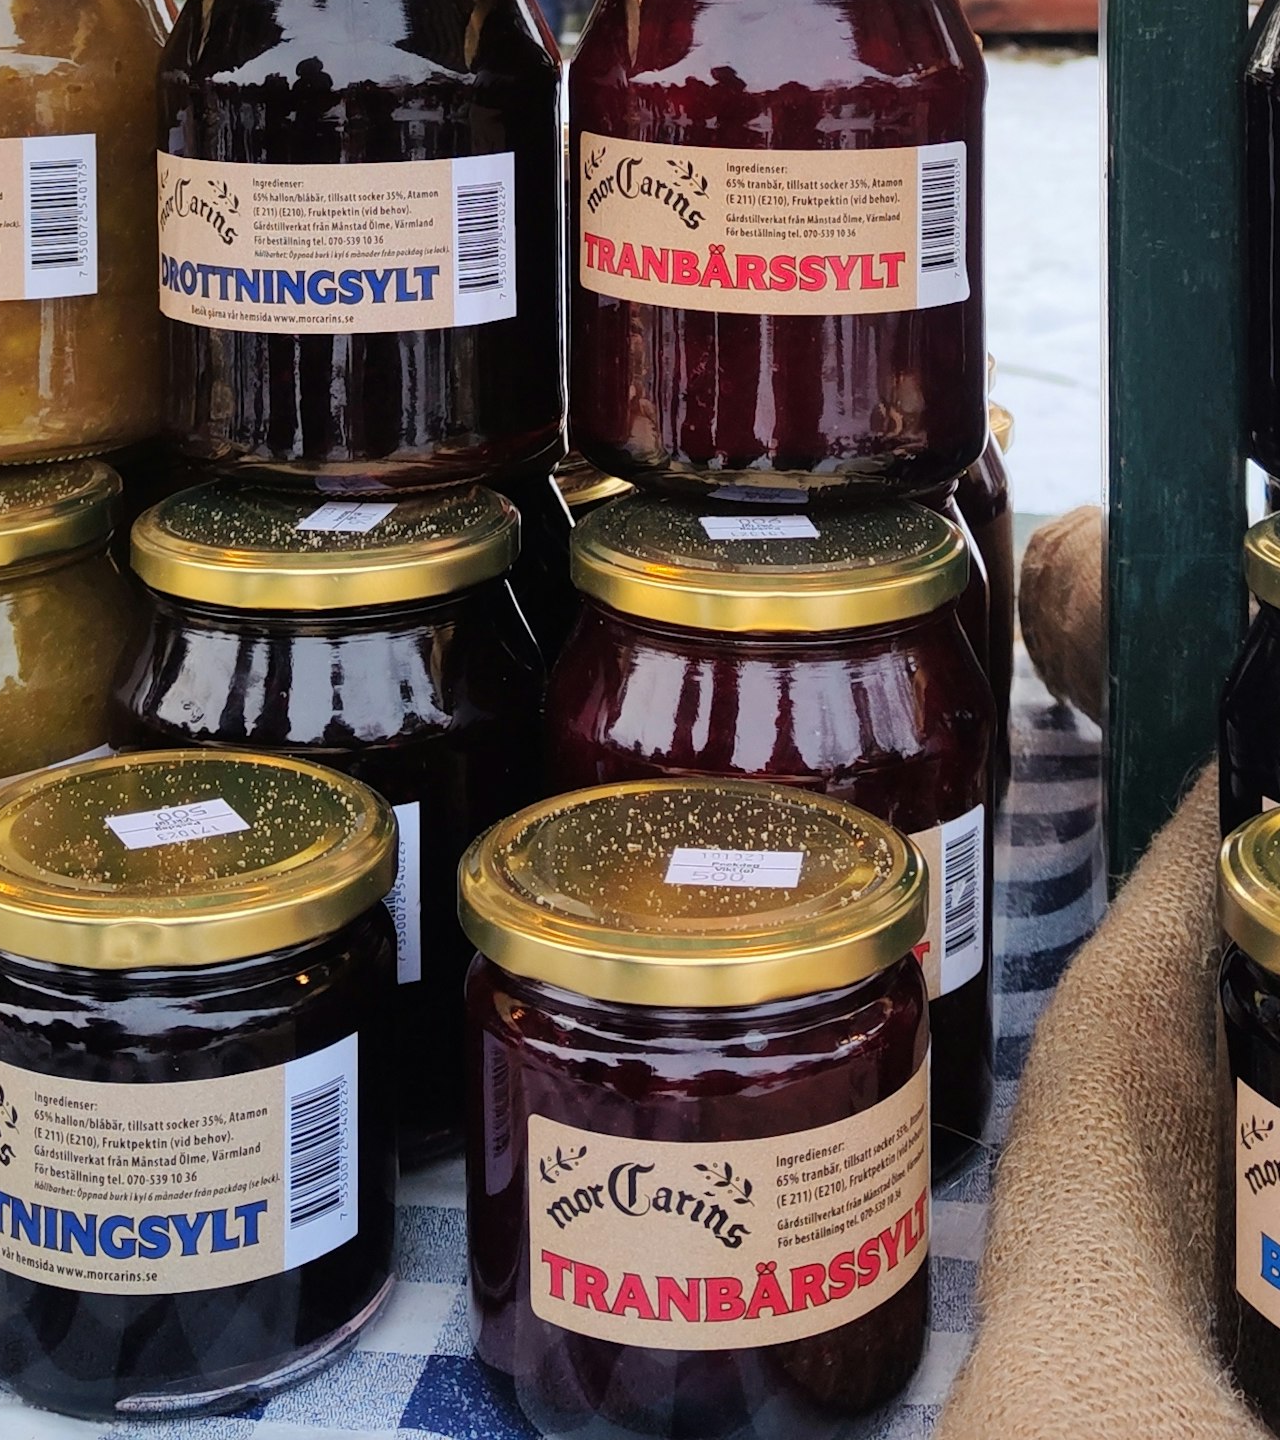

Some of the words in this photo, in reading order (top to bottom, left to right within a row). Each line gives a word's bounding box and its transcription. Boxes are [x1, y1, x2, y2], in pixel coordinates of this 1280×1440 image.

[174, 179, 238, 246] Carins
[586, 175, 614, 214] mor
[616, 157, 706, 230] Carins
[726, 178, 745, 189] 65%
[747, 179, 785, 190] tranbär,
[786, 180, 818, 190] tillsatt
[820, 180, 849, 190] socker
[850, 180, 870, 191] 35%,
[872, 177, 903, 189] Atamon
[160, 251, 440, 305] DROTTNINGSYLT
[584, 232, 906, 293] TRANBÄRSSYLT
[273, 314, 355, 325] www.morcarins.se
[34, 1110, 53, 1123] 65%
[55, 1115, 125, 1132] hallon/blåbär,
[128, 1120, 164, 1132] tillsatt
[166, 1118, 200, 1130] socker
[202, 1115, 227, 1127] 35%,
[228, 1107, 268, 1124] Atamon
[546, 1182, 603, 1230] mor
[608, 1162, 752, 1249] Carins
[56, 1266, 157, 1283] www.morcarins.se
[541, 1186, 928, 1323] TRANBÄRSSYLT
